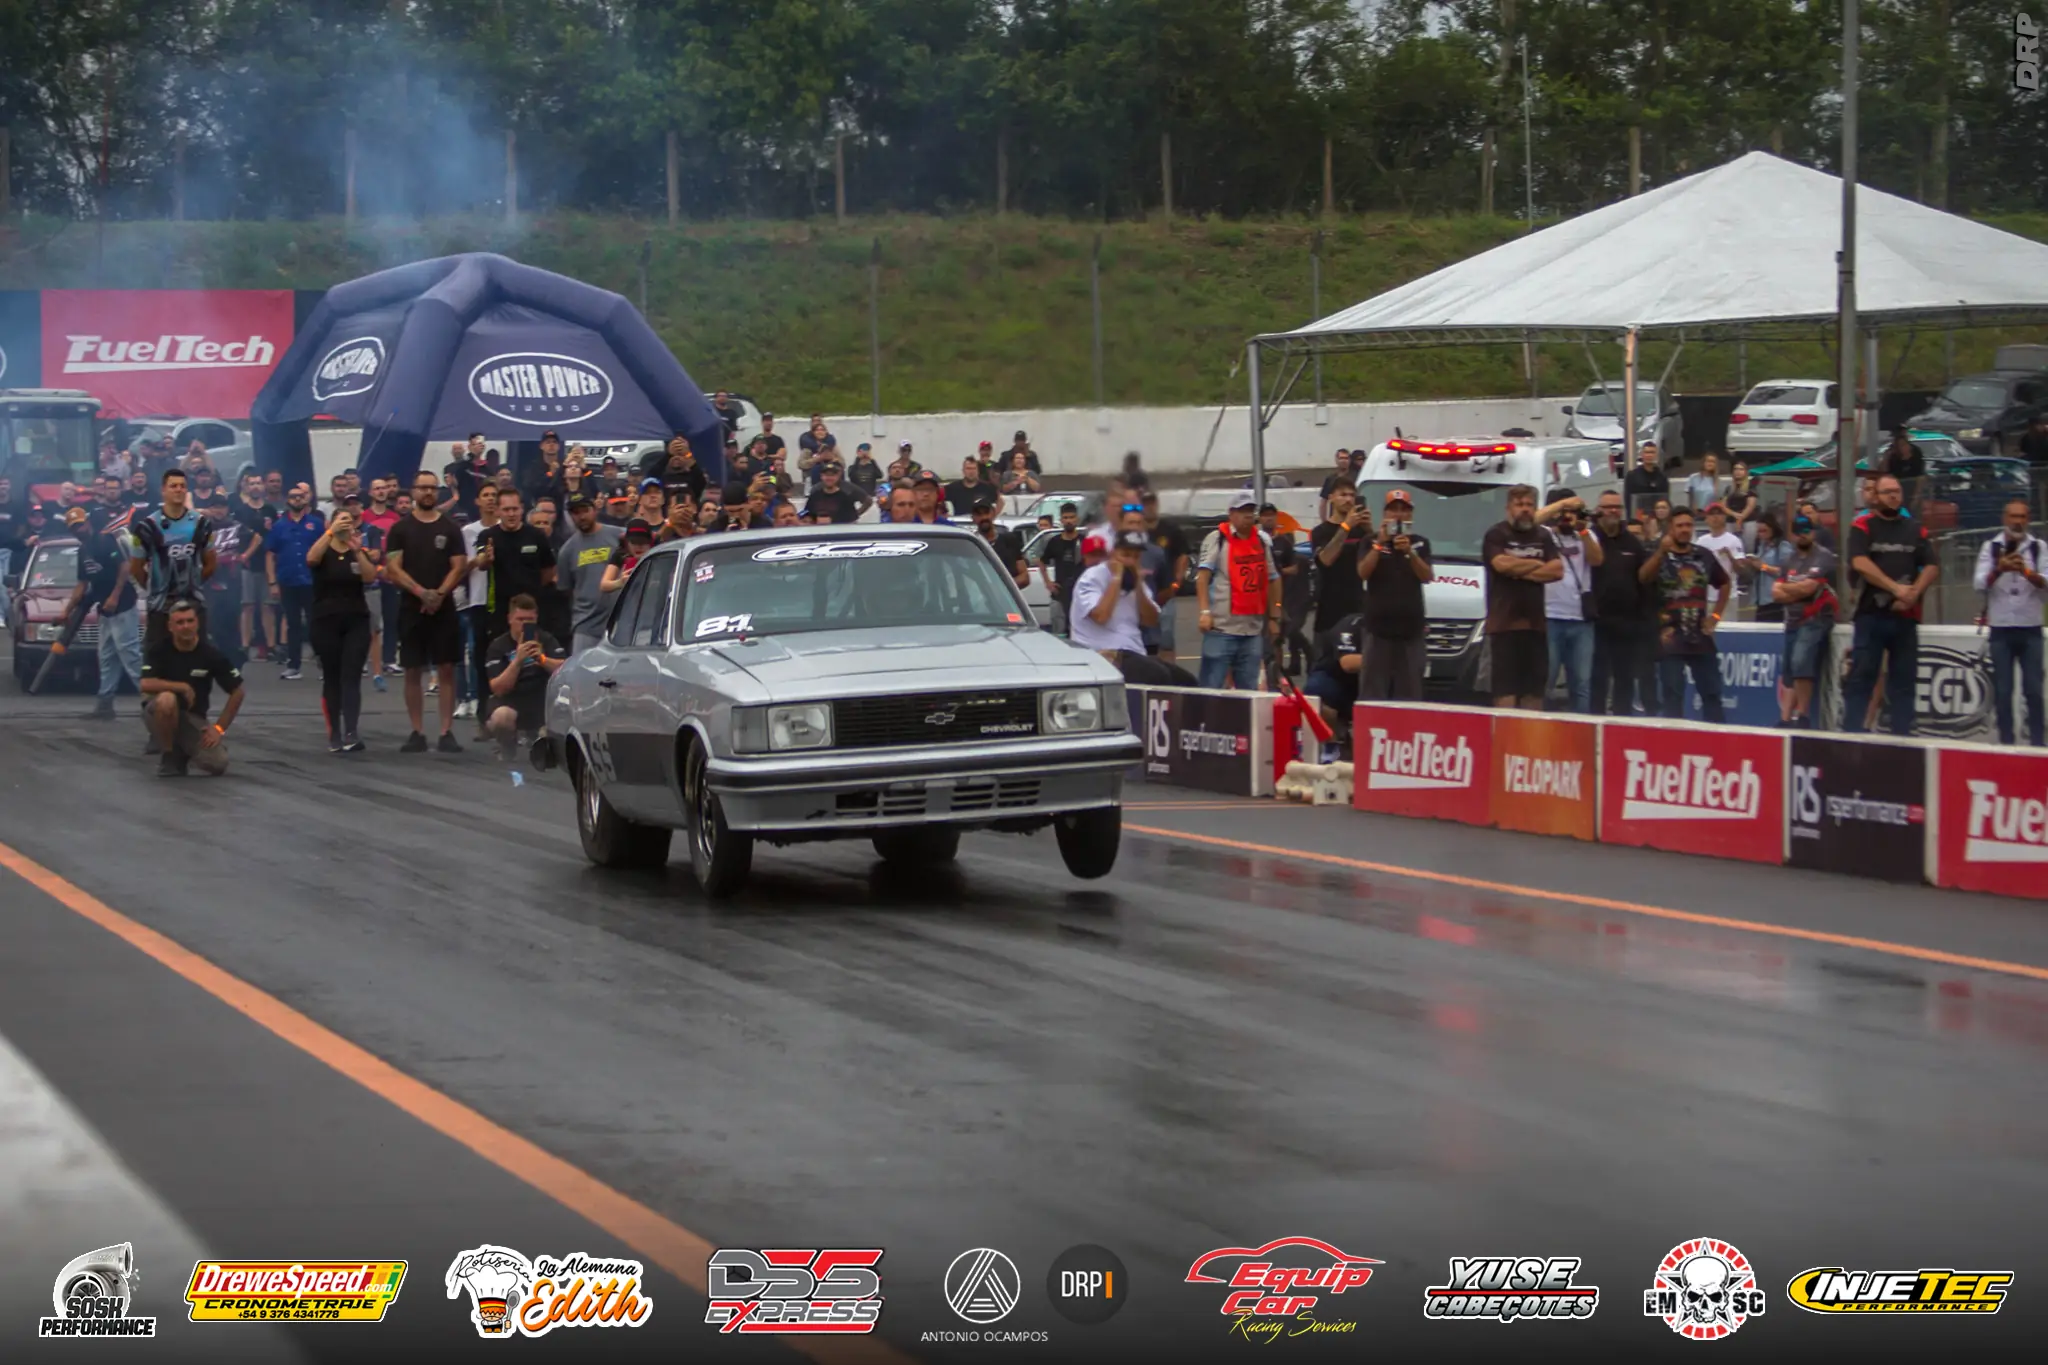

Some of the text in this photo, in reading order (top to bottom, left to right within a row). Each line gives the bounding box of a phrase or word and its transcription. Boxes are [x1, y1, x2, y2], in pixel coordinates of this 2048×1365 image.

[64, 334, 275, 367] FuelTech
[479, 364, 601, 398] MASTER POWER
[980, 724, 1034, 733] CHEVROLET
[1148, 699, 1170, 758] RS
[1368, 727, 1475, 788] FuelTech
[1504, 752, 1584, 801] VELOPARK
[1621, 748, 1762, 819] FuelTech
